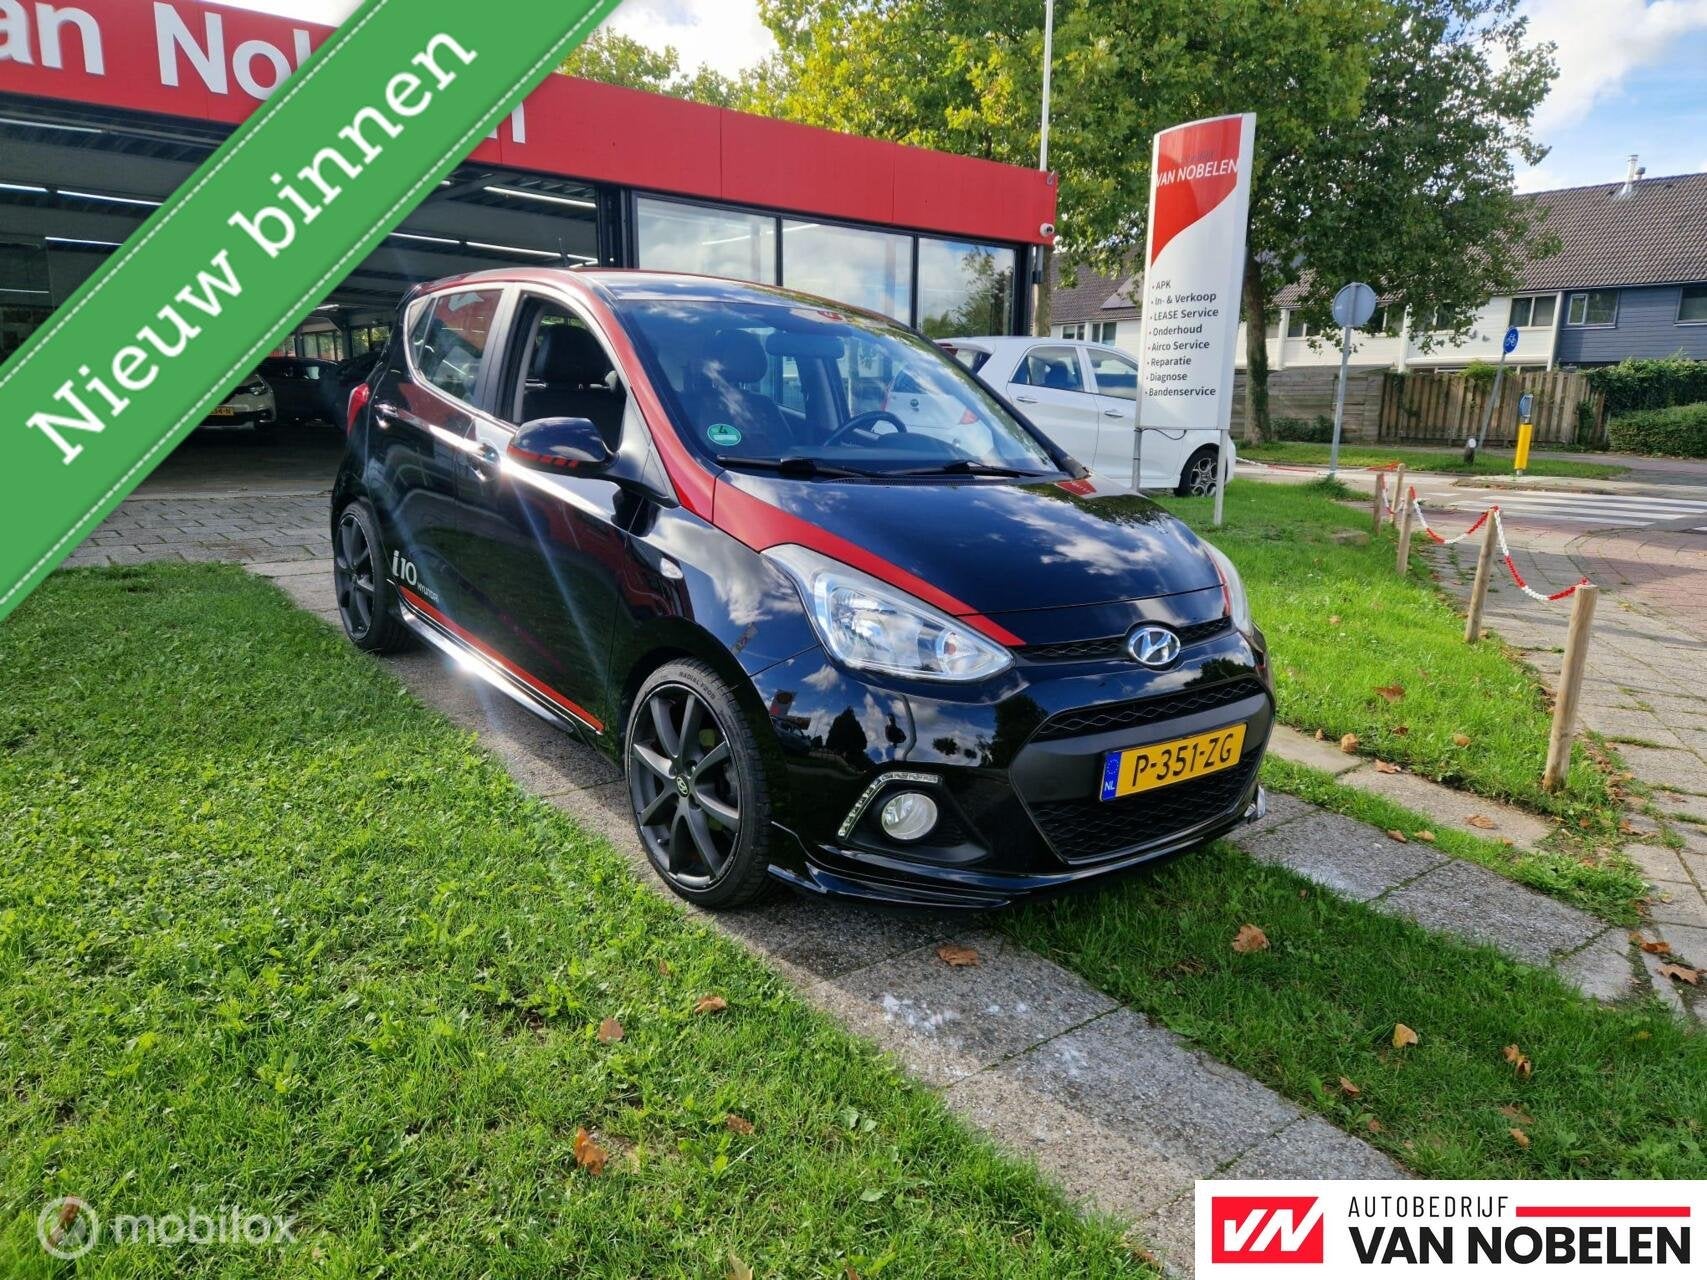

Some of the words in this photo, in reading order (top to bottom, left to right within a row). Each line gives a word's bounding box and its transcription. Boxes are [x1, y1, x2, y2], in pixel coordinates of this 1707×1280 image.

[1156, 169, 1176, 187] VAN
[1177, 158, 1240, 182] NOBELEN
[1156, 280, 1171, 289] APK
[1167, 295, 1173, 304] &
[1175, 292, 1217, 303] Verkoop
[1154, 310, 1179, 321] LEASE
[1181, 307, 1219, 318] Service
[1153, 324, 1203, 336] Onderhoud
[1151, 342, 1171, 351] Airco
[1173, 339, 1210, 350] Service
[1151, 356, 1192, 367] Reparatie
[1150, 372, 1188, 383] Diagnose
[1149, 386, 1216, 396] Bandenservice
[392, 550, 417, 585] i10
[1132, 733, 1234, 787] P-351-ZG
[1104, 780, 1116, 791] NL
